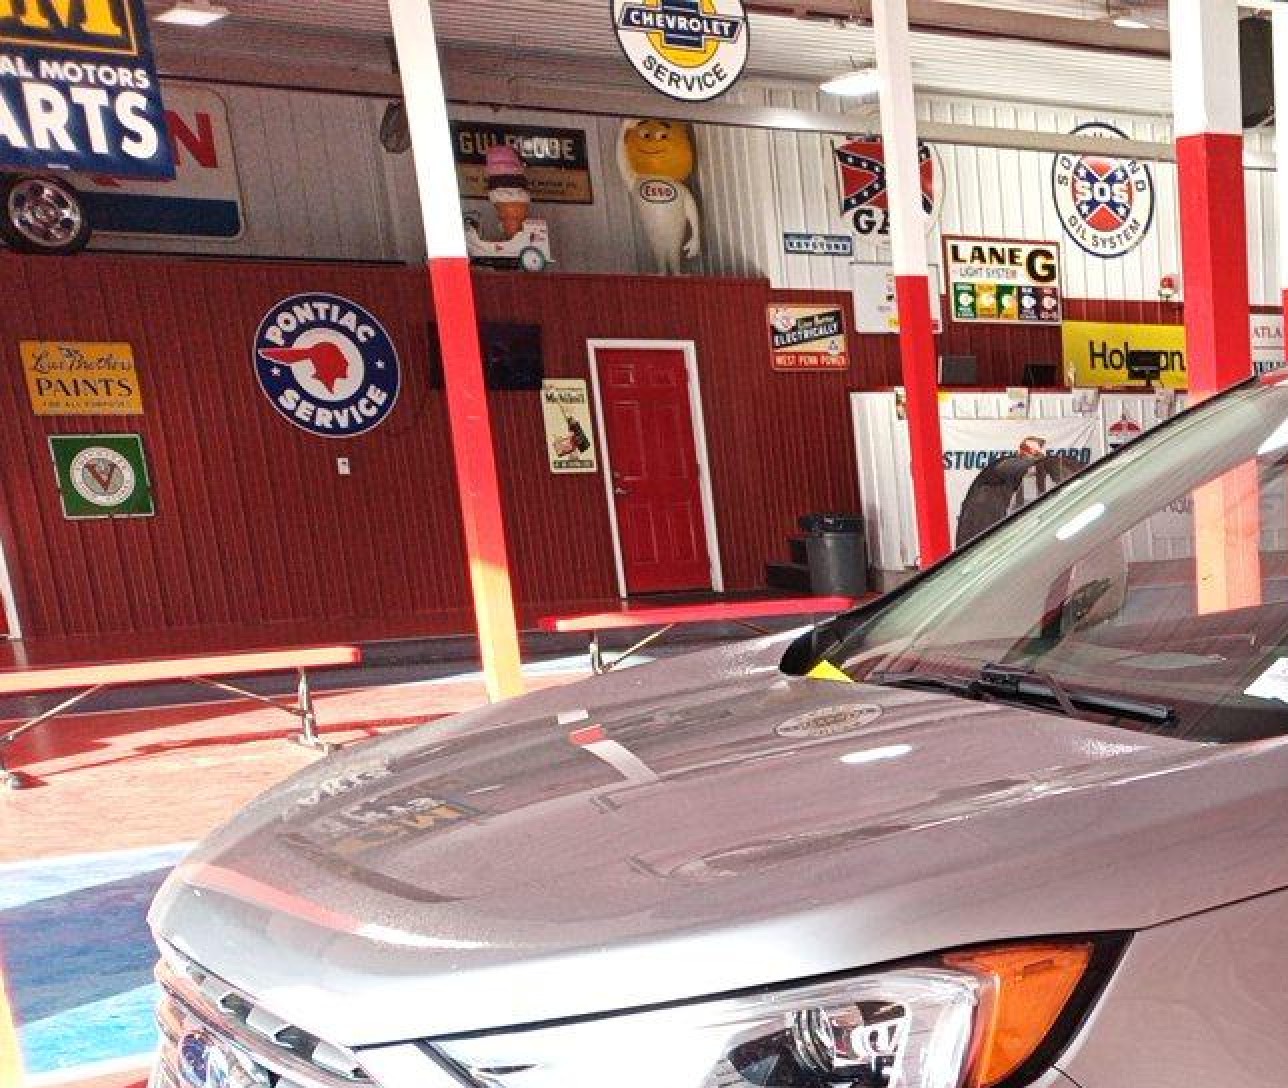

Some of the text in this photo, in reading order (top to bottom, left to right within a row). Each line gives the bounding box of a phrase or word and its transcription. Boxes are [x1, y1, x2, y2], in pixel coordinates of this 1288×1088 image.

[629, 10, 732, 36] CHEVROLET
[39, 59, 151, 89] MOTORS
[641, 54, 727, 92] SERVICE
[1075, 181, 1133, 203] SOS
[1091, 218, 1141, 249] SYSTEM
[950, 244, 1057, 283] LANE G
[265, 301, 375, 345] PONTIAC
[773, 321, 839, 347] ELECTRICALLY
[775, 355, 796, 367] WEST
[1089, 340, 1186, 372] Holan
[36, 377, 133, 397] PAINTS
[277, 385, 389, 429] SERVICE
